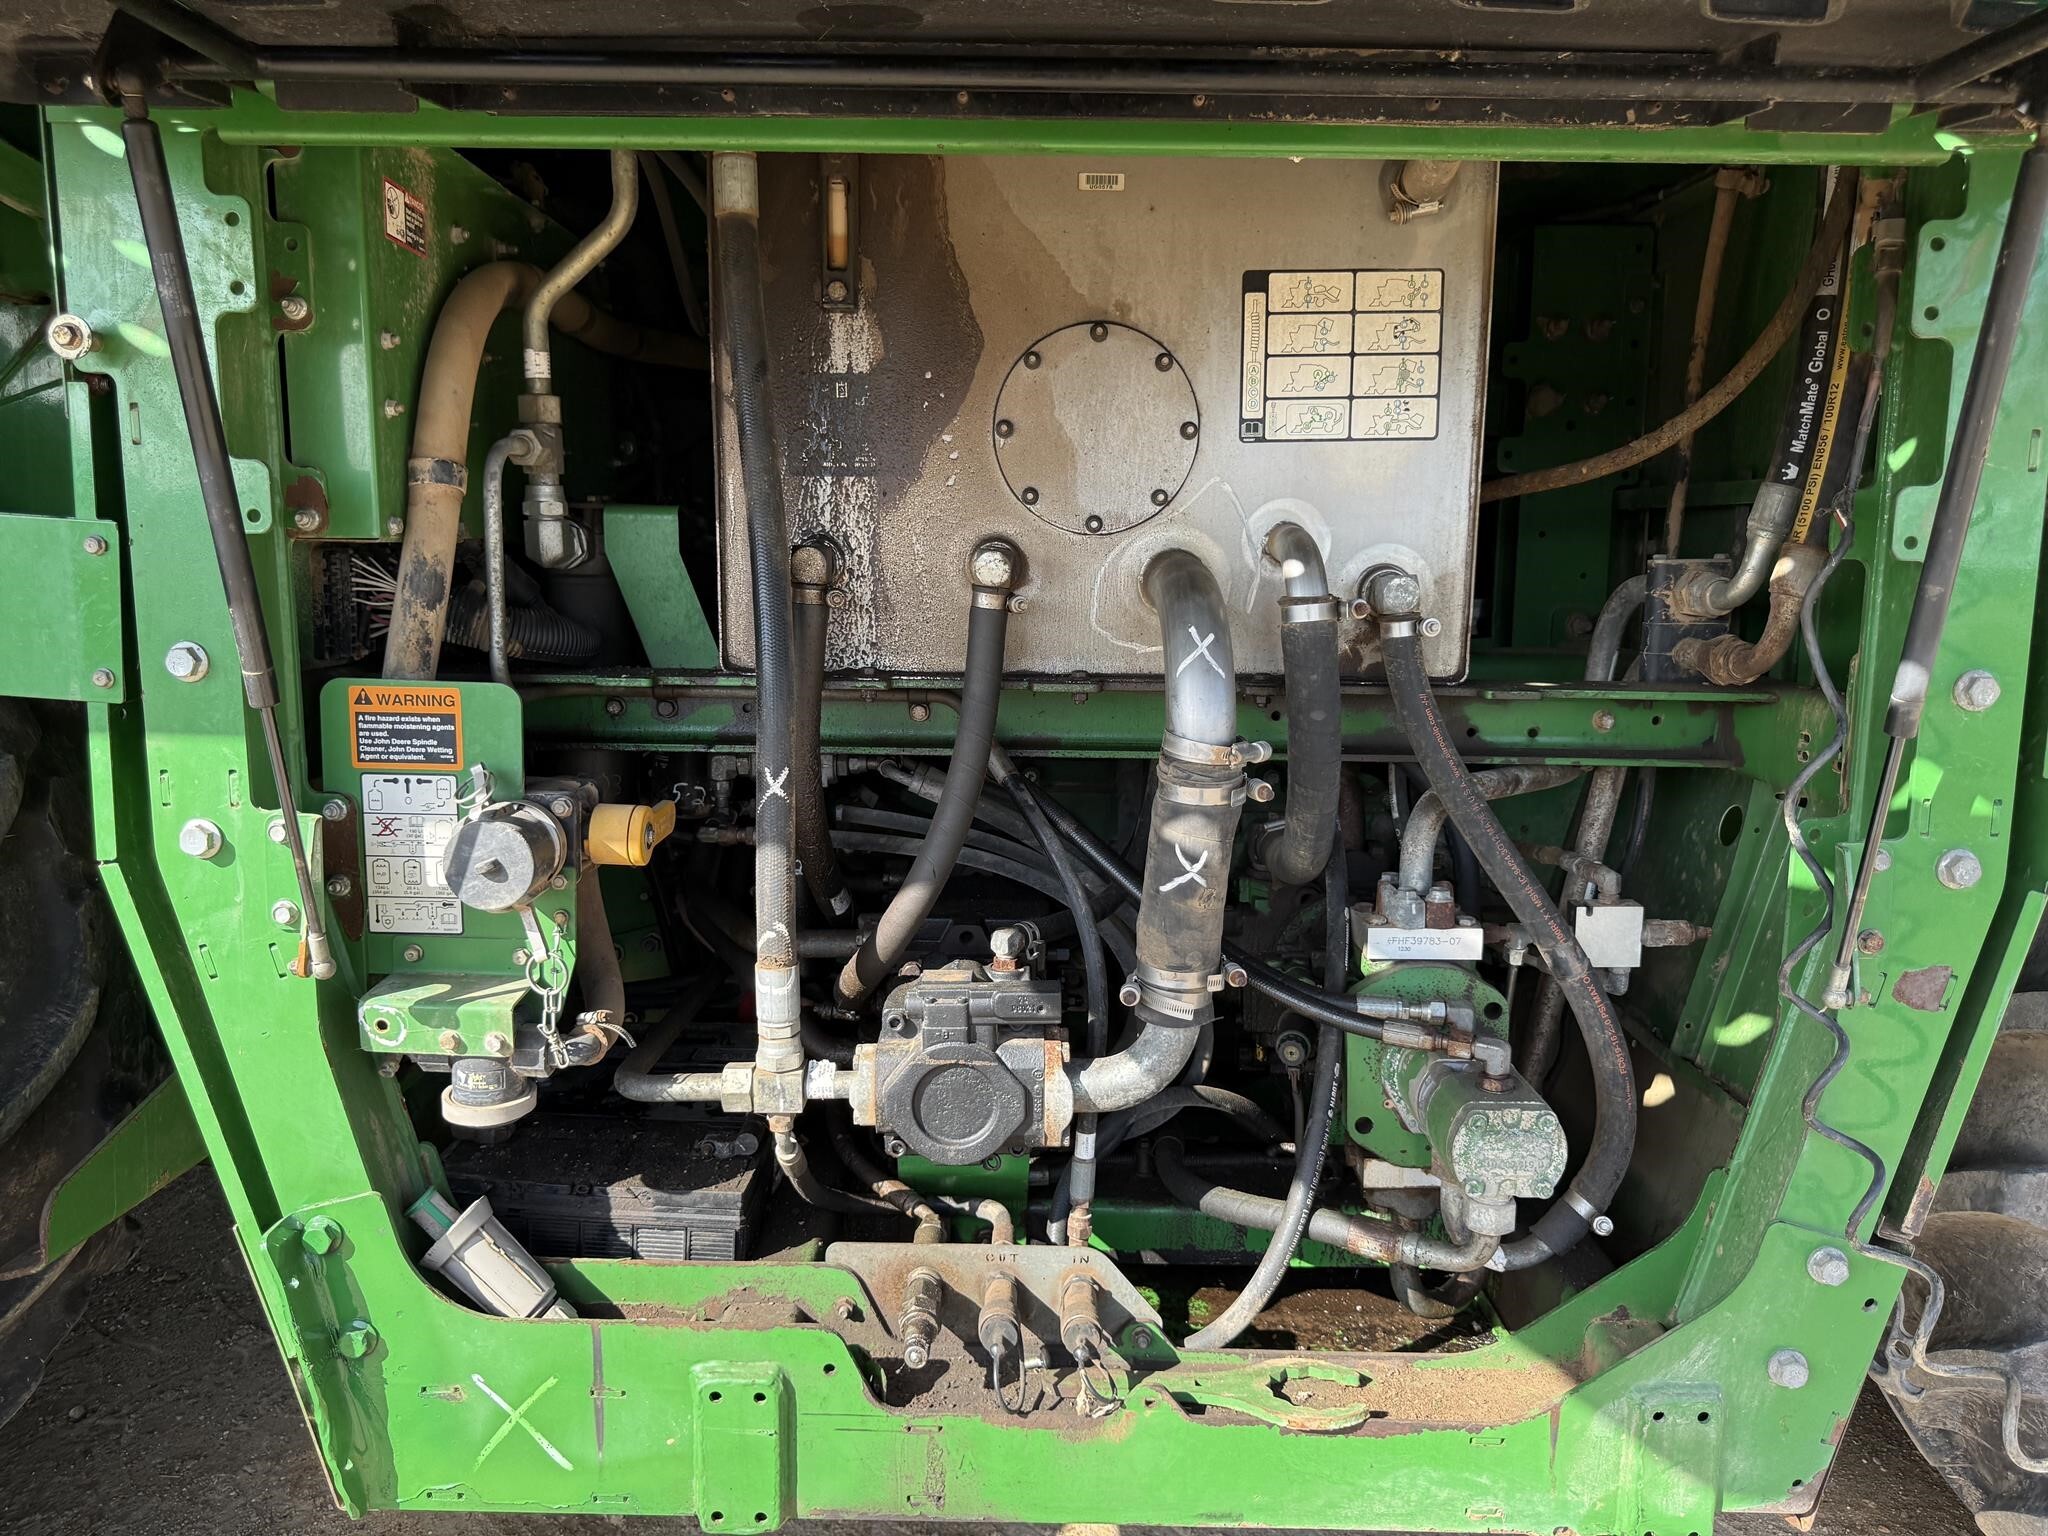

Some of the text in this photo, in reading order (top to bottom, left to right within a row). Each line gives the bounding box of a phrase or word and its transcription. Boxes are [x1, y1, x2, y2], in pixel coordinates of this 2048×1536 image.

[1808, 331, 1829, 373] Global
[1824, 383, 1840, 424] 100R12
[1812, 434, 1829, 470] EN856
[1806, 473, 1822, 496] PSI)
[1796, 498, 1812, 528] (5100
[376, 694, 456, 707] WARNING
[394, 723, 430, 731] moistening
[986, 1253, 1090, 1264] OUT IN
